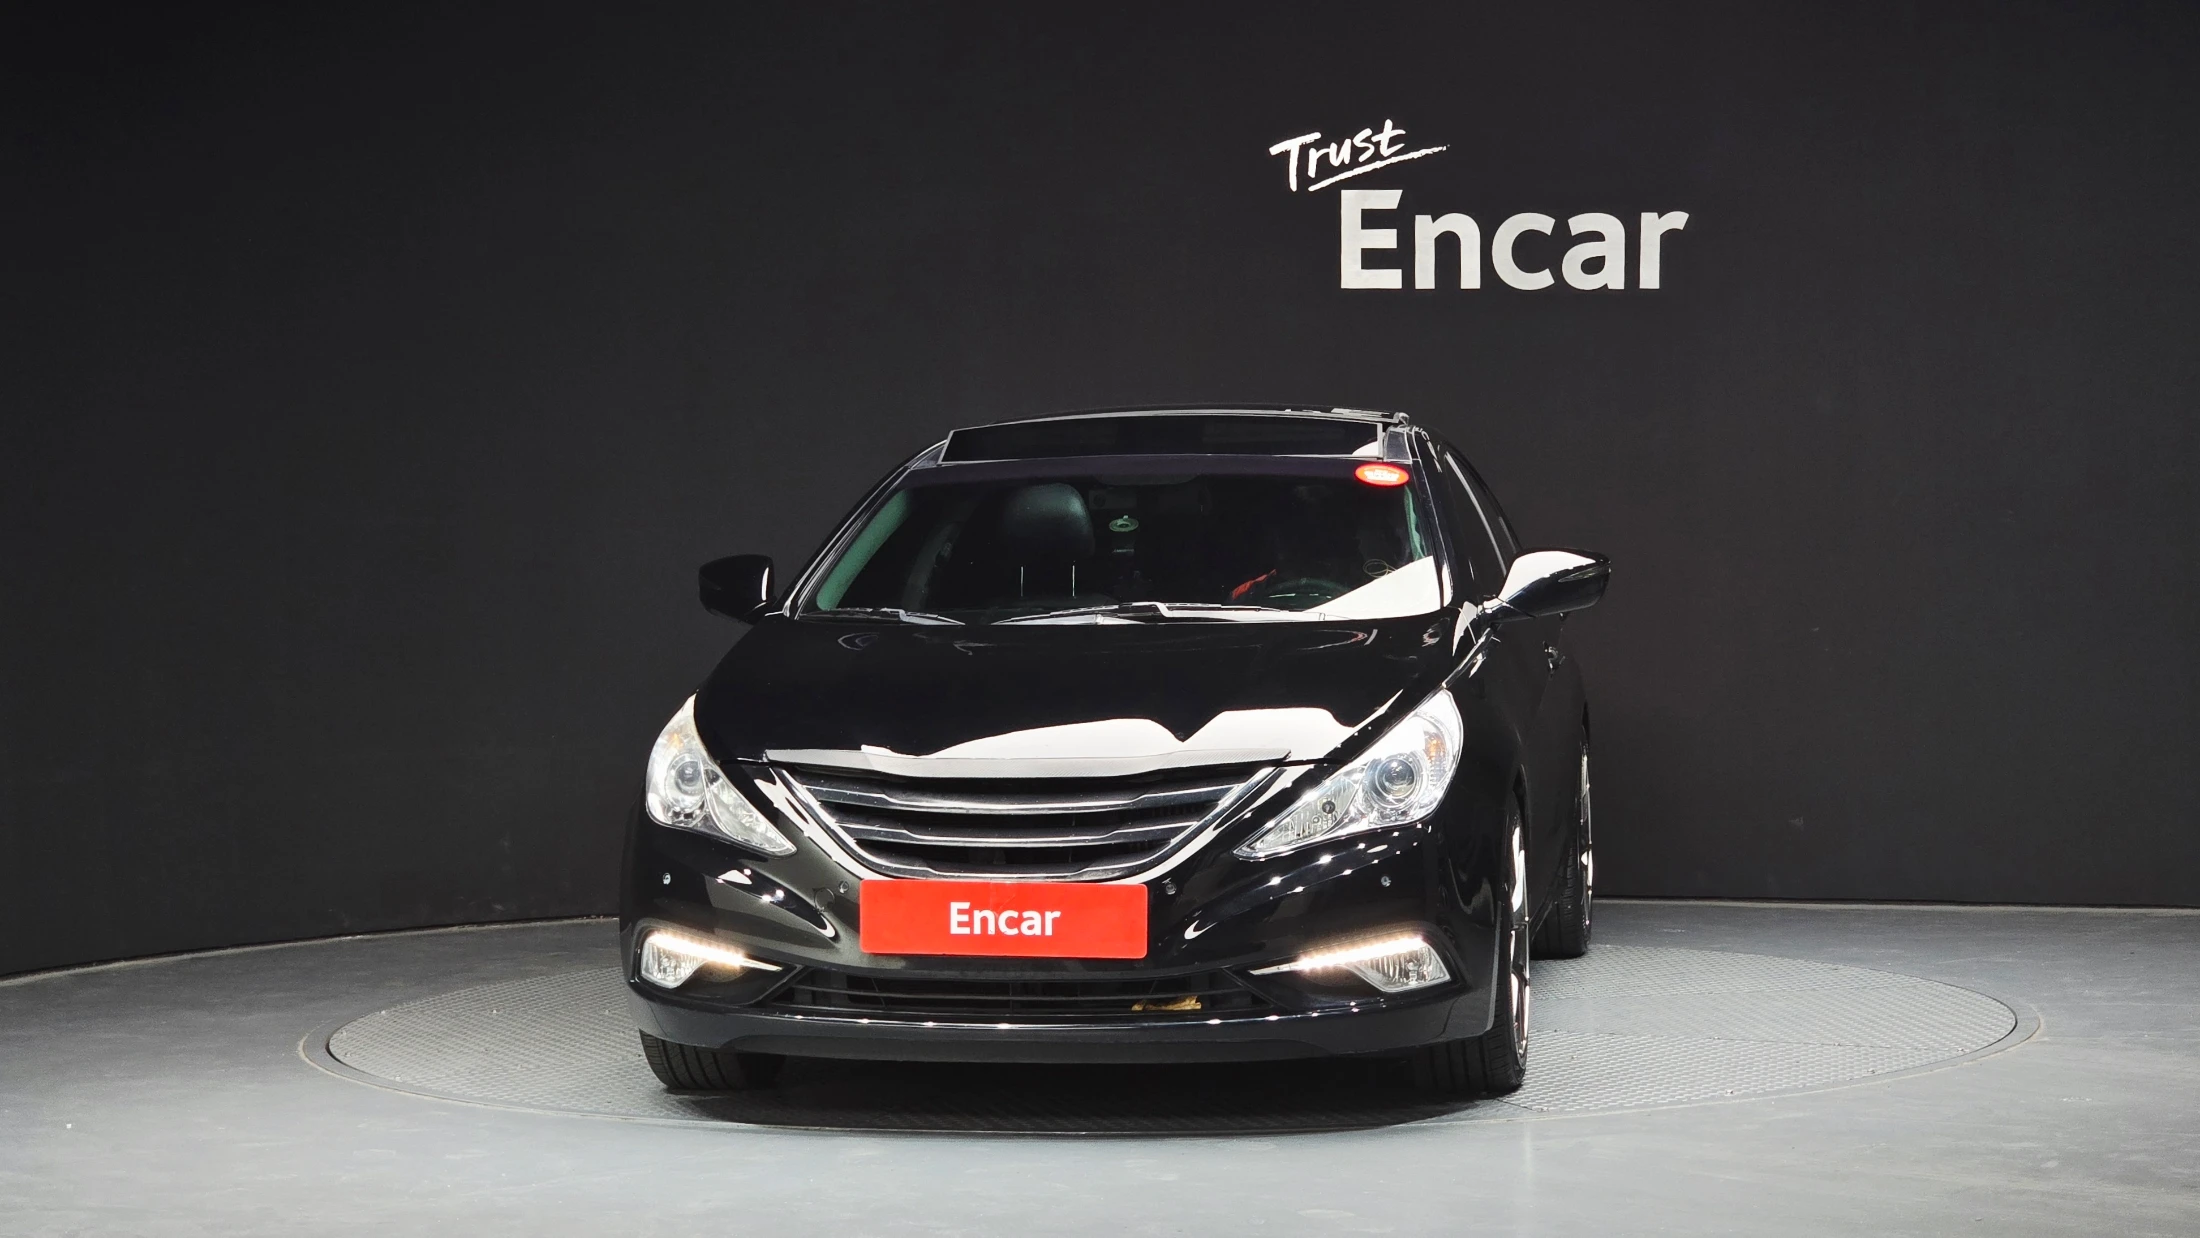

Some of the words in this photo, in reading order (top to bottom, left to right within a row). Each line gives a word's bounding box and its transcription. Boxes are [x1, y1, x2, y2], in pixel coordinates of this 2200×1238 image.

[1269, 119, 1406, 192] Trust
[1340, 190, 1689, 290] Encar
[950, 902, 1061, 936] Encar
